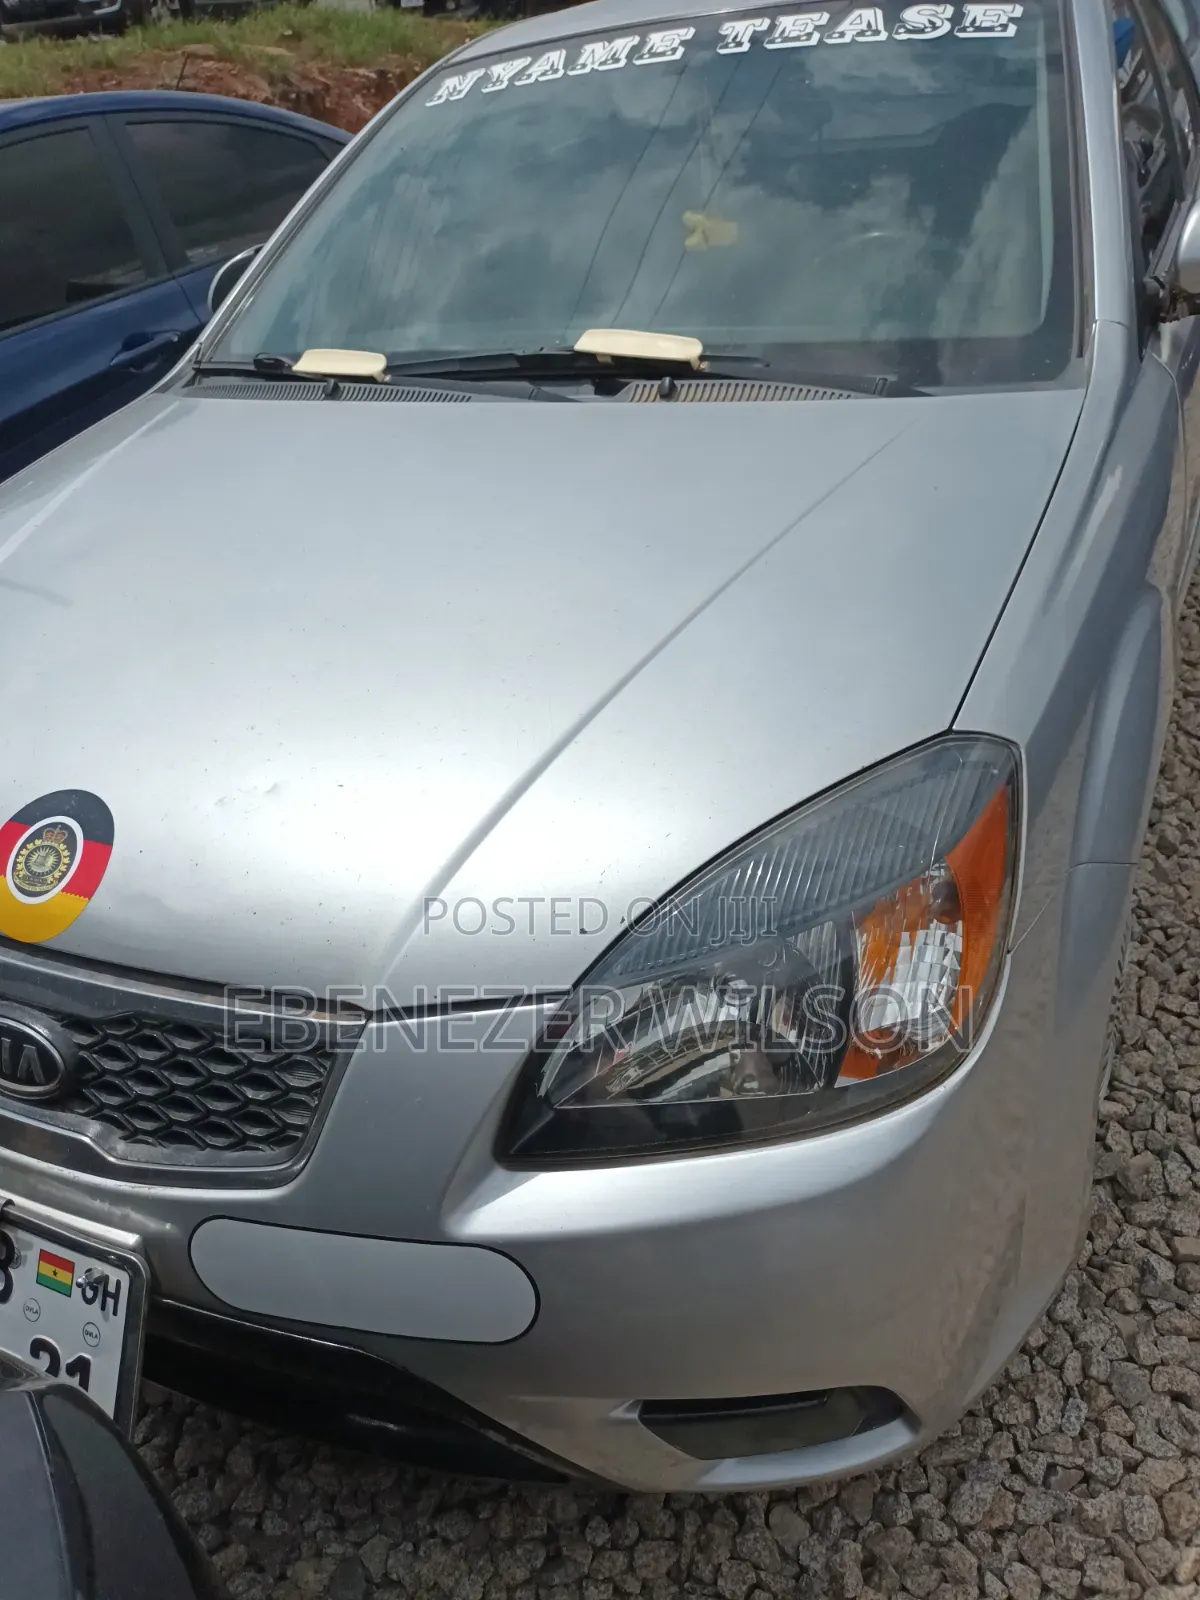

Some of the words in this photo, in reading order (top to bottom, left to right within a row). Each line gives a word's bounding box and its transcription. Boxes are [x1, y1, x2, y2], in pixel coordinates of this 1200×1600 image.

[425, 27, 695, 107] NYAME
[716, 4, 1024, 54] TEASE
[0, 1037, 46, 1085] IA
[81, 1267, 122, 1316] GH
[84, 1329, 99, 1339] DVLA
